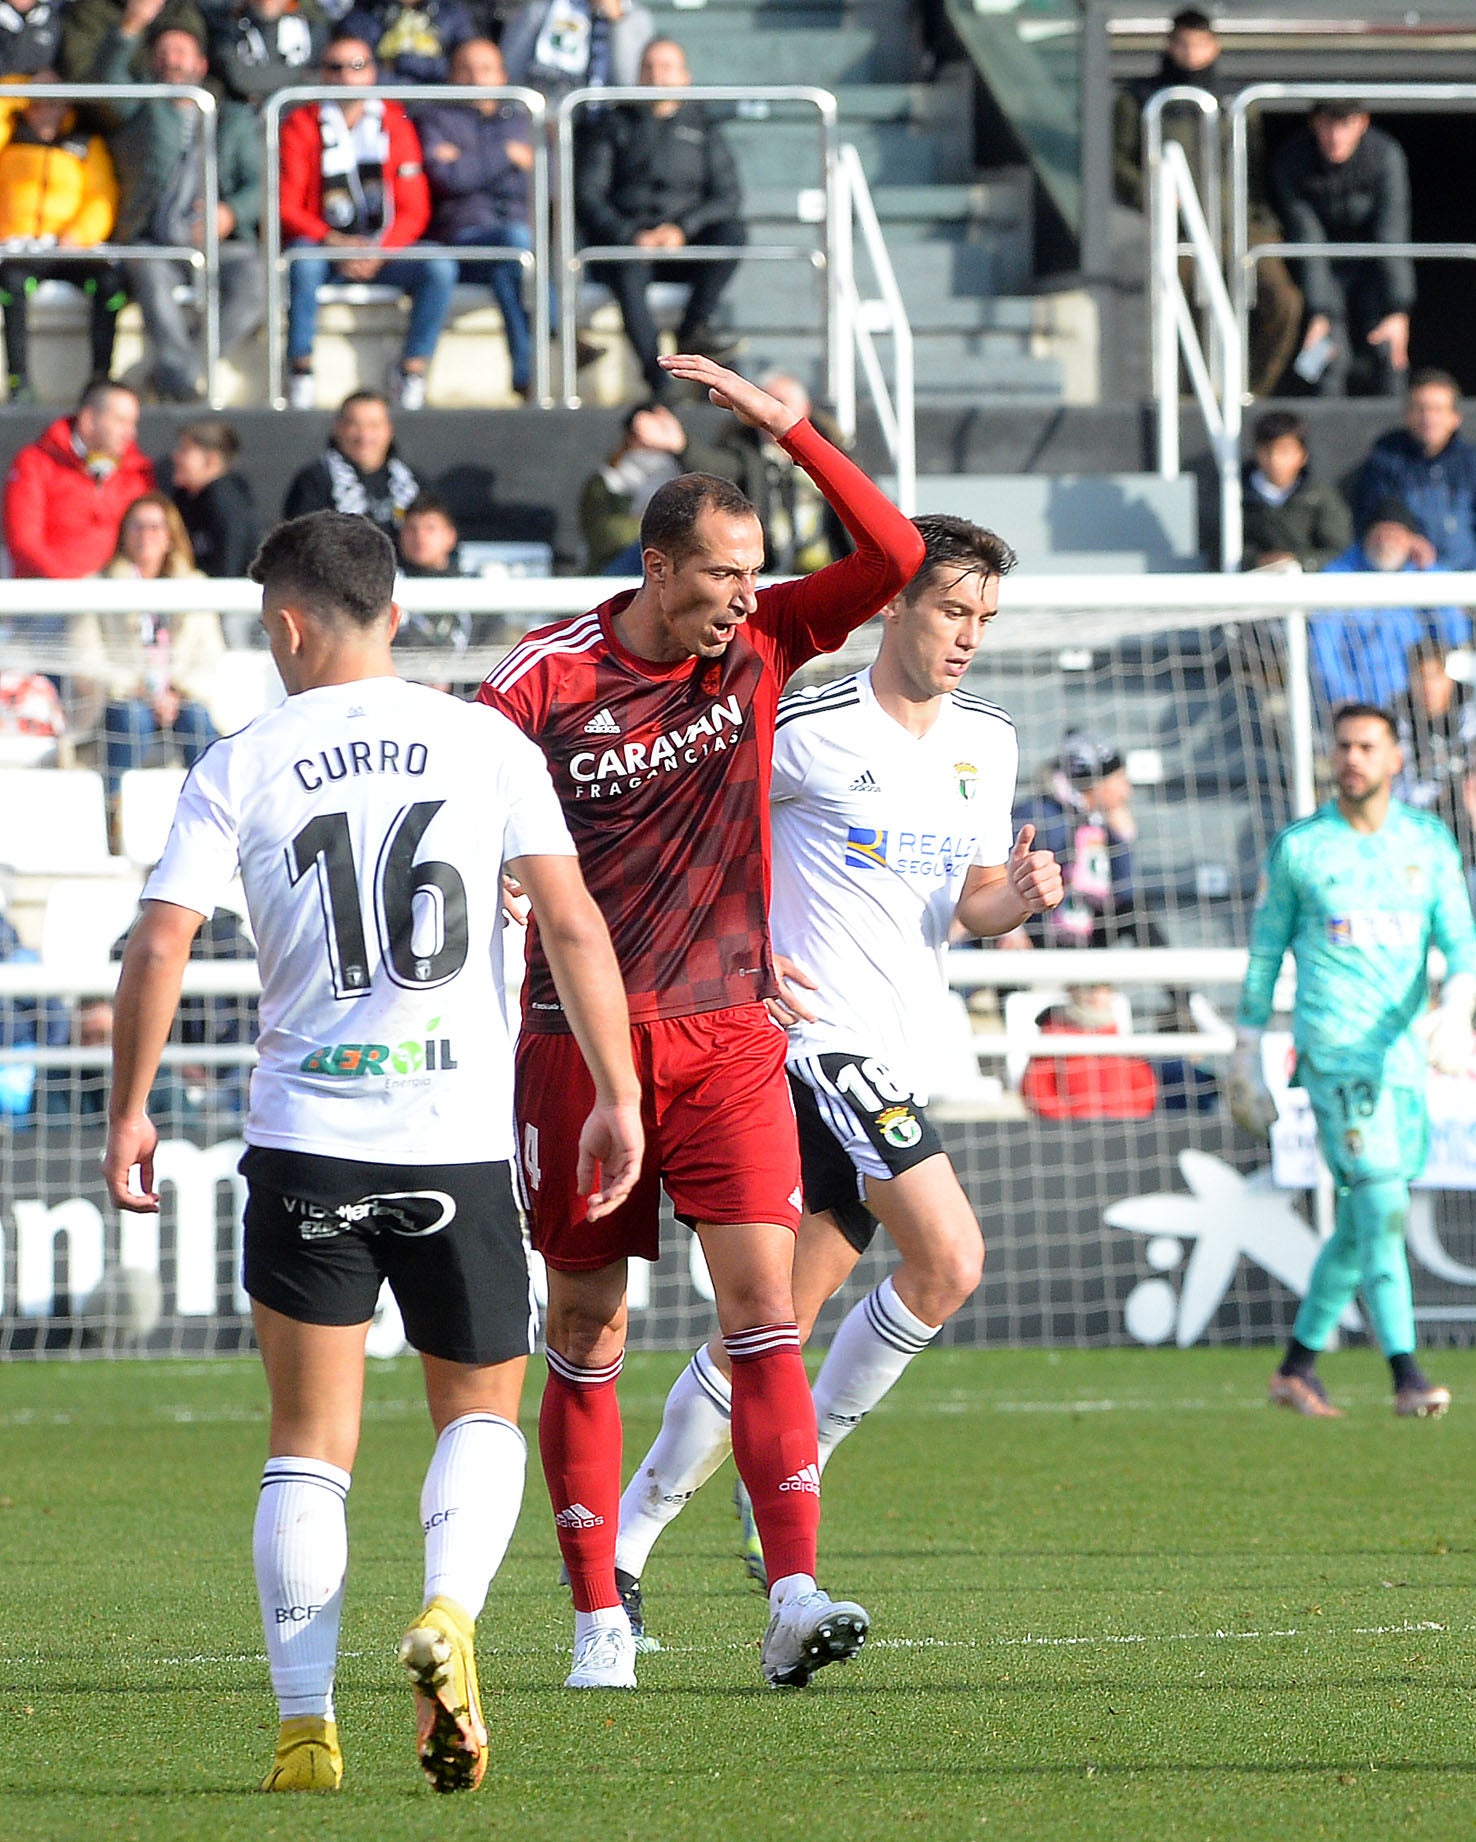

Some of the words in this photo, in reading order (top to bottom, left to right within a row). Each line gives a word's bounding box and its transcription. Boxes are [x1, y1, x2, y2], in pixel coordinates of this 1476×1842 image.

[569, 694, 744, 782] CARAVAN
[293, 740, 428, 793] CURRO
[895, 859, 966, 877] SEGUO
[284, 799, 469, 1000] 16
[835, 1058, 914, 1113] 18
[524, 1121, 542, 1191] 4
[779, 1479, 821, 1498] adid
[275, 1604, 322, 1624] BCF
